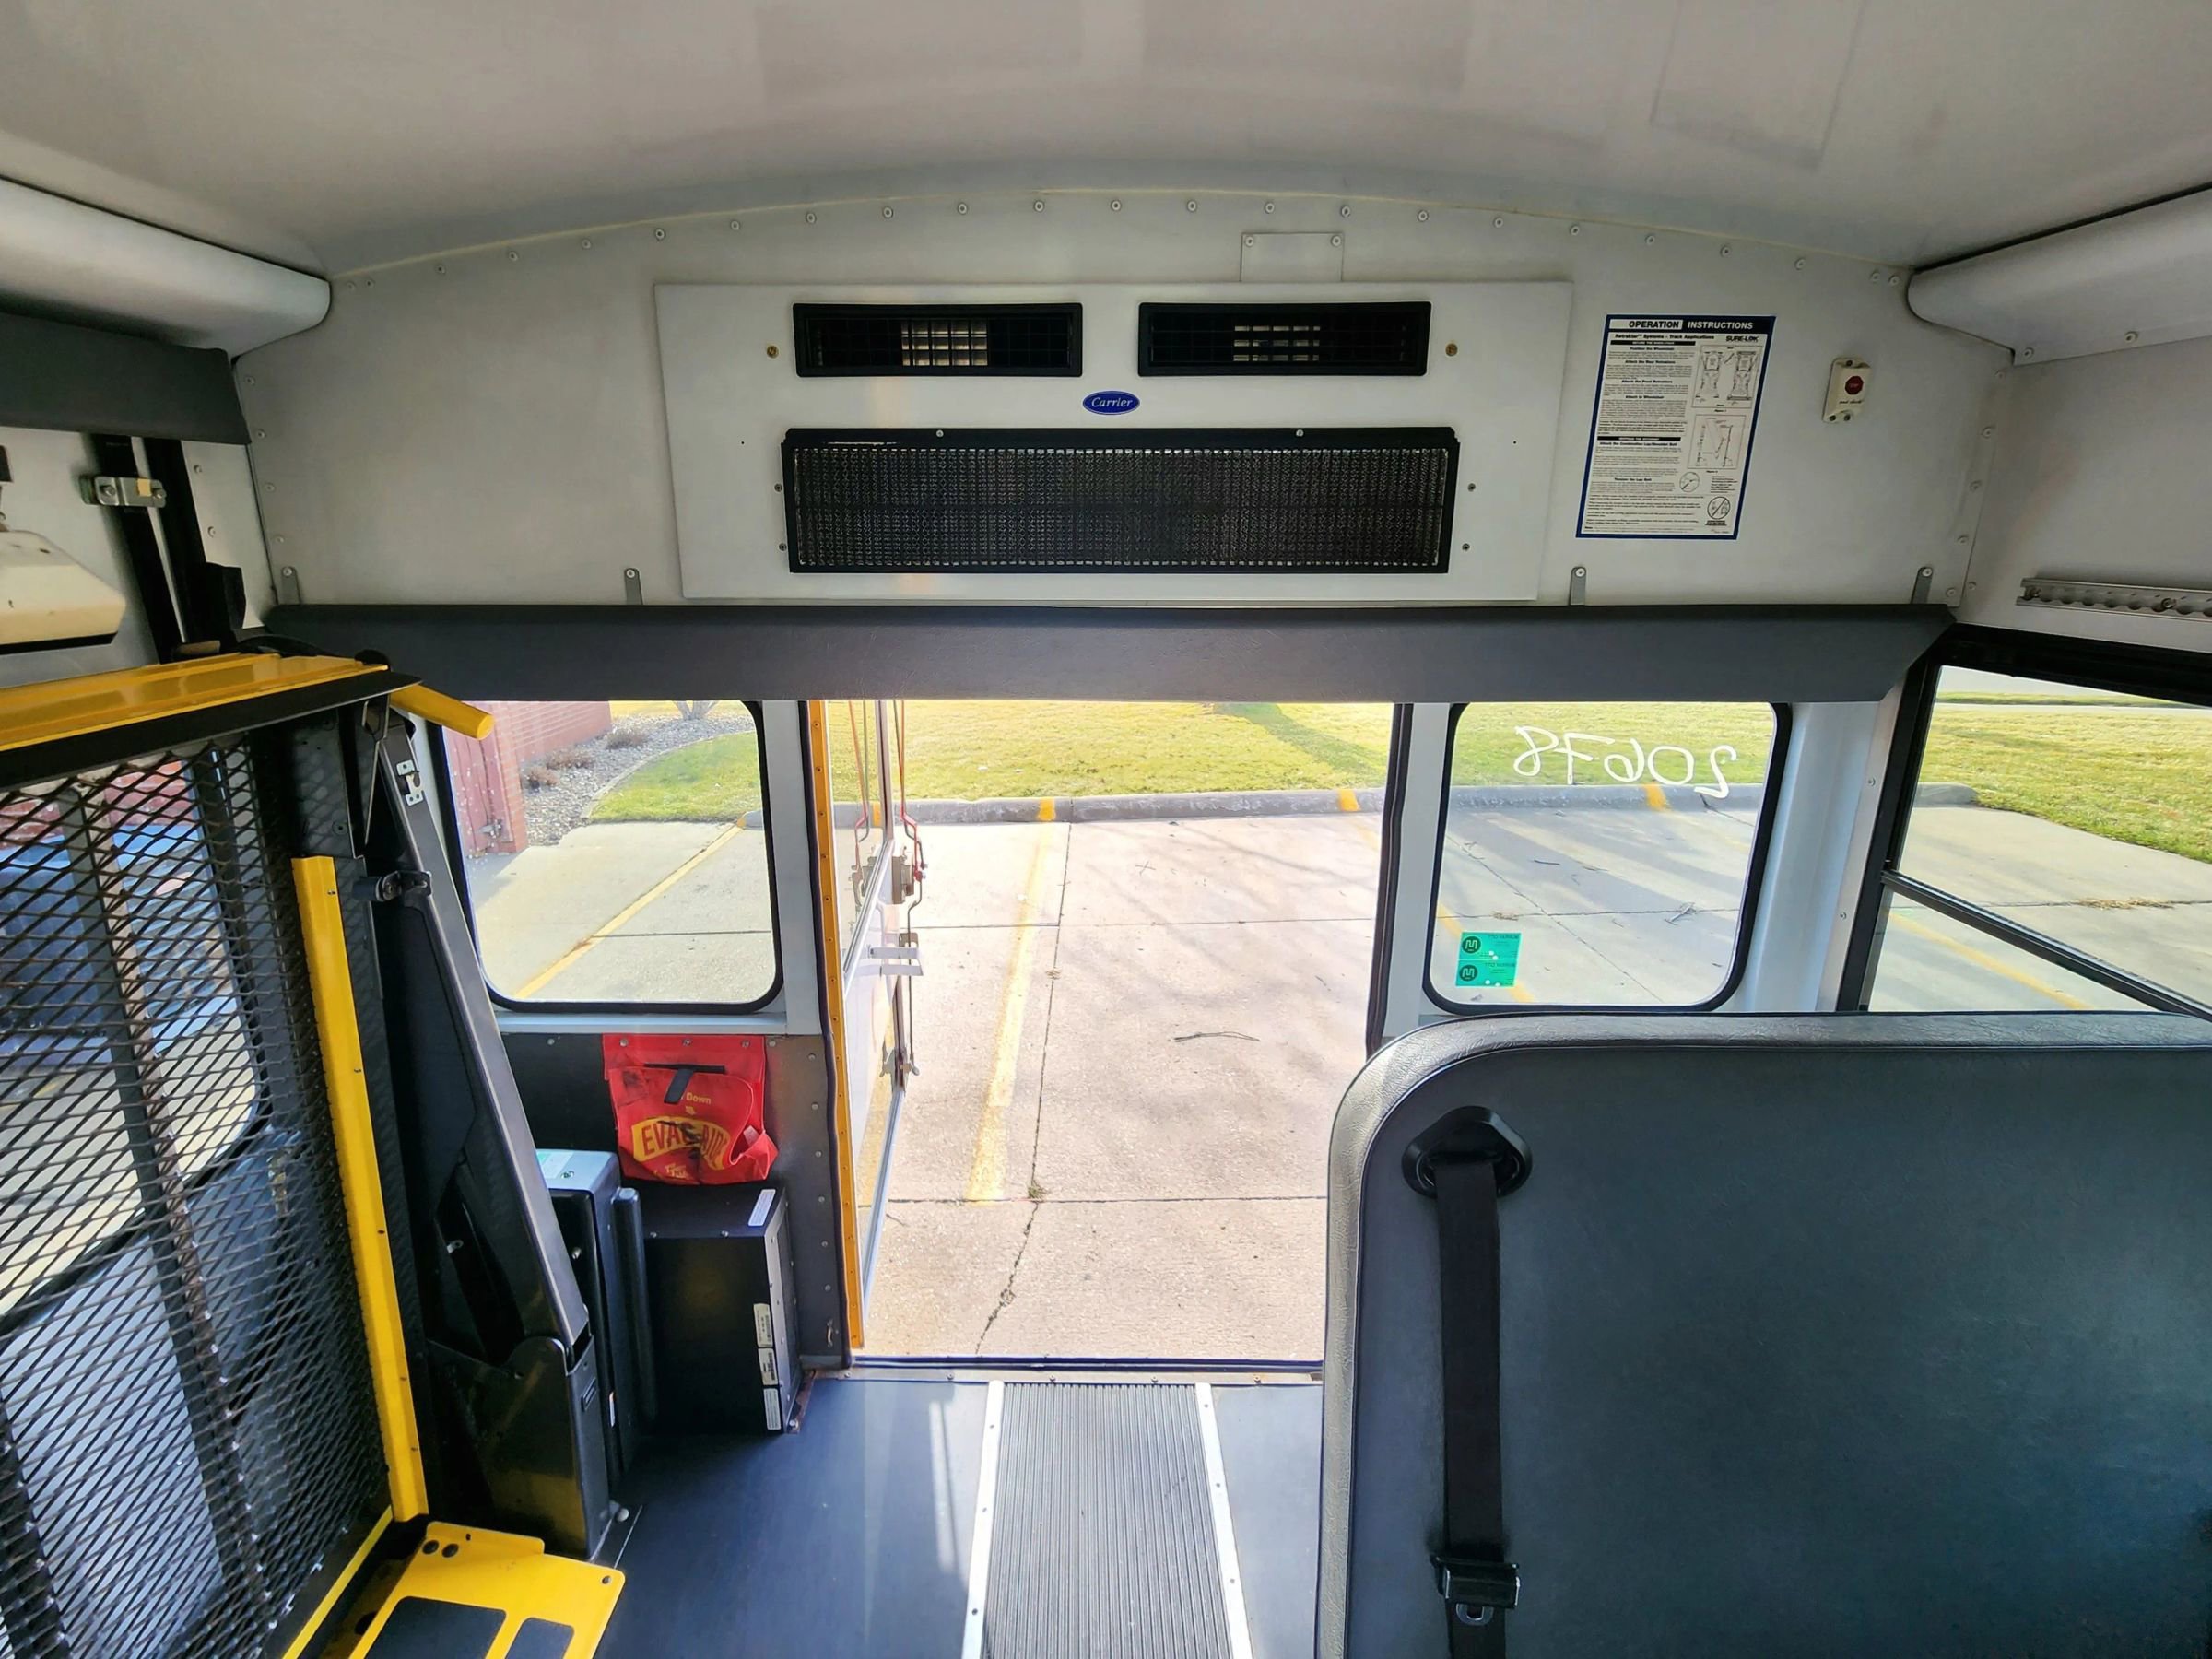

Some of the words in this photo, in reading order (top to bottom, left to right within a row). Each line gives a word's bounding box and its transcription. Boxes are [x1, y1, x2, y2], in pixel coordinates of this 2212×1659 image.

[1629, 319, 1679, 329] OPERATION
[1687, 321, 1754, 330] INSTRUCTIONS
[1091, 397, 1133, 407] Carrier
[686, 1092, 712, 1105] Down
